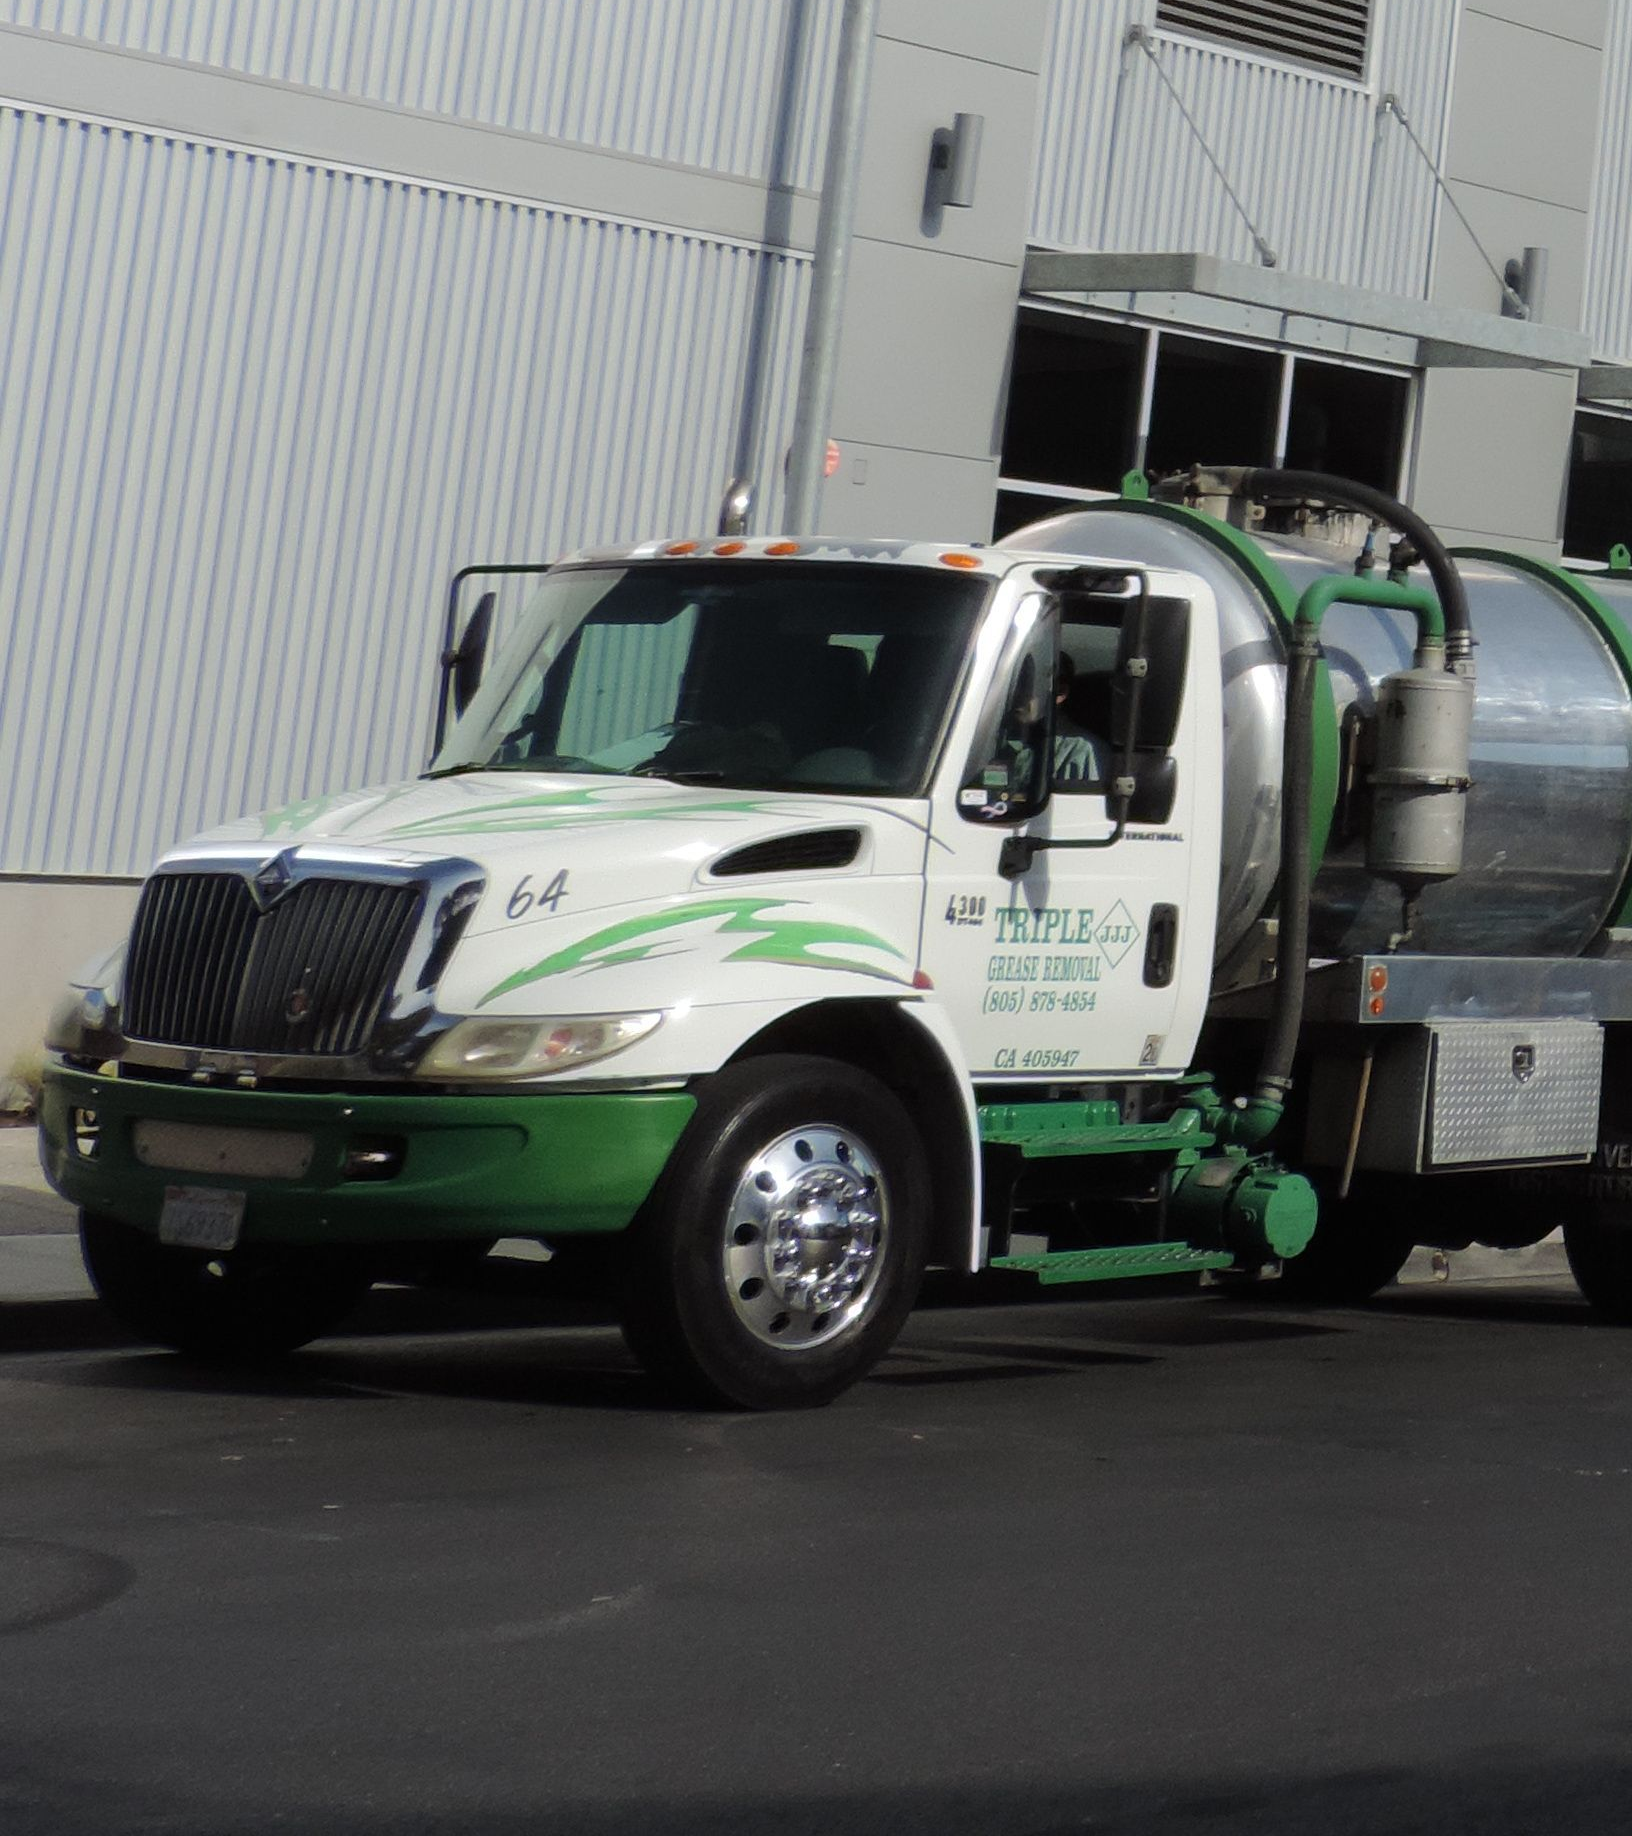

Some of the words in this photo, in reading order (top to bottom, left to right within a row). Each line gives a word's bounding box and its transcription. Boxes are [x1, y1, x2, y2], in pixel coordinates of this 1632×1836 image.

[506, 868, 569, 919] 64
[945, 894, 987, 925] 4300
[994, 907, 1094, 944] TRIPLE
[1100, 925, 1132, 943] JJJ
[987, 955, 1040, 982] GREASE
[1042, 955, 1101, 982] REMOVAL
[982, 985, 1025, 1015] (805)
[1029, 990, 1097, 1012] 878-4854
[994, 1048, 1017, 1068] CA
[1022, 1049, 1080, 1068] 405947
